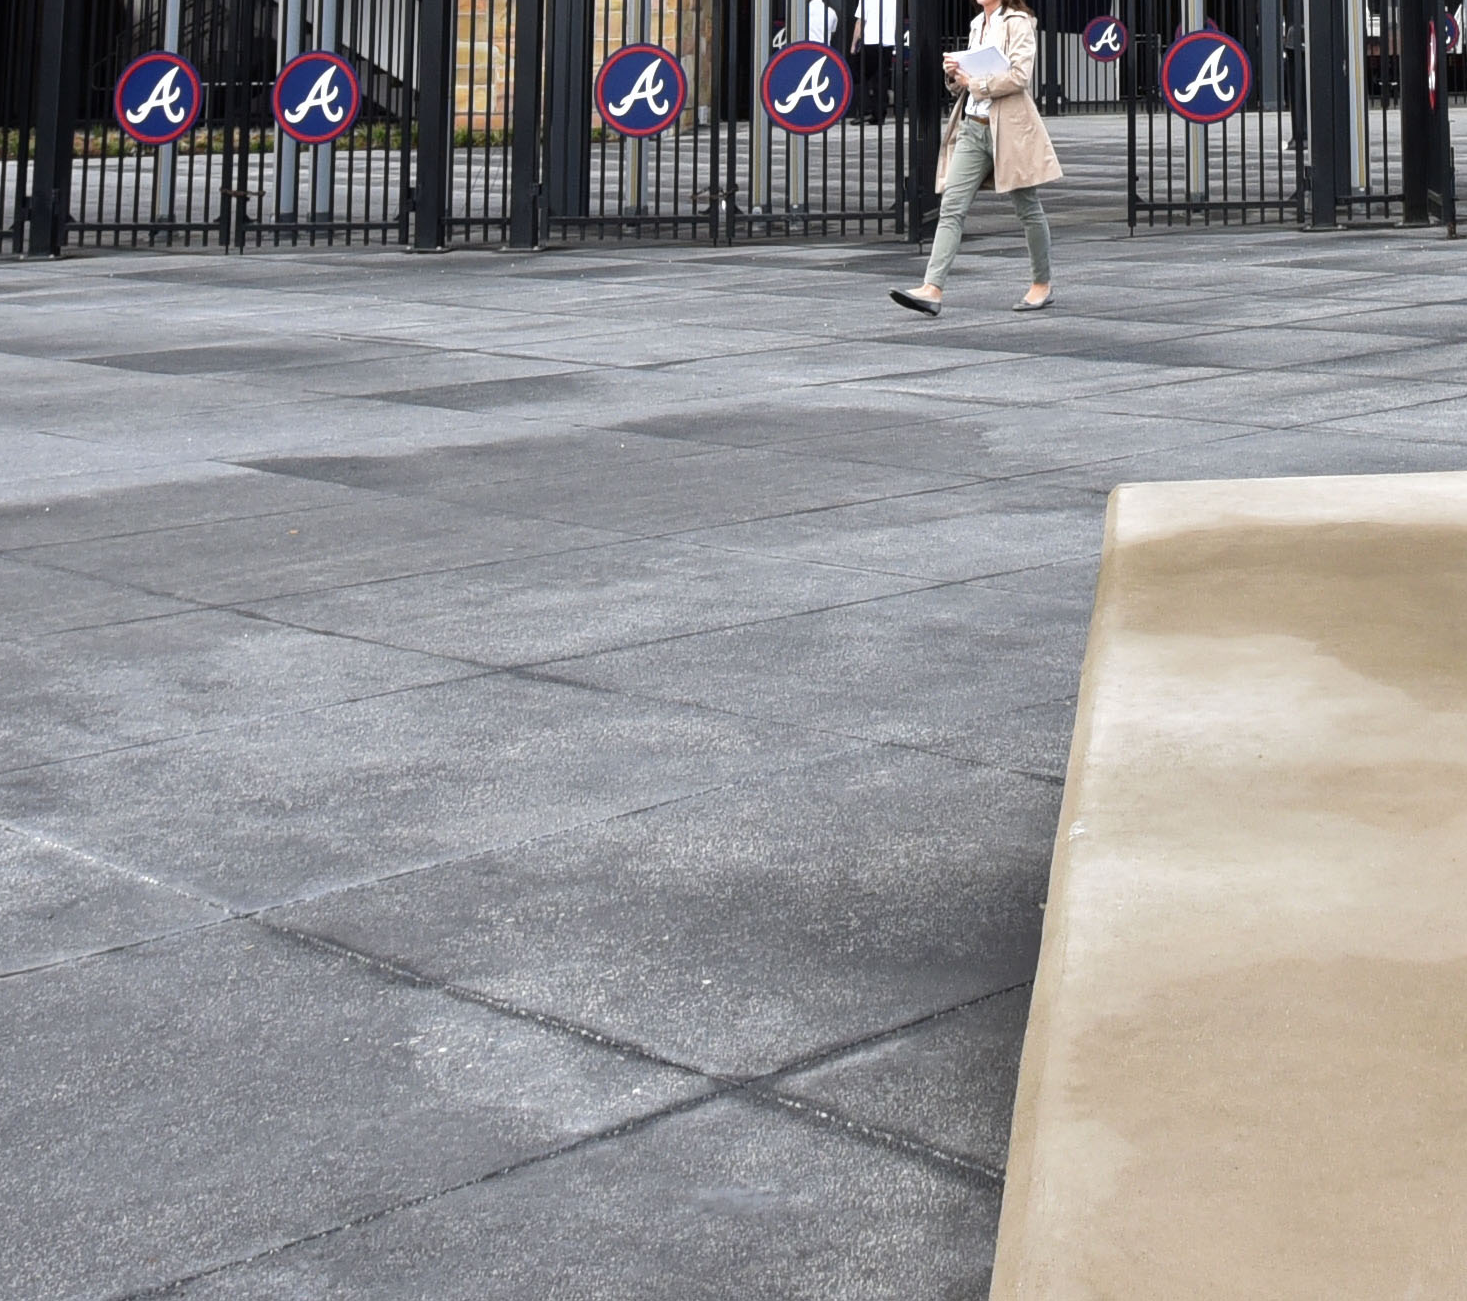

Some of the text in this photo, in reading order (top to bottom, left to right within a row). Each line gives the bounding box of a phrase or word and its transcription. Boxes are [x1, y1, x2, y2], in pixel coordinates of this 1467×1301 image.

[1090, 23, 1120, 51] A
[126, 66, 184, 123] A
[285, 65, 343, 123] A
[609, 58, 669, 116] A
[775, 56, 834, 113] A
[1174, 45, 1234, 102] A
